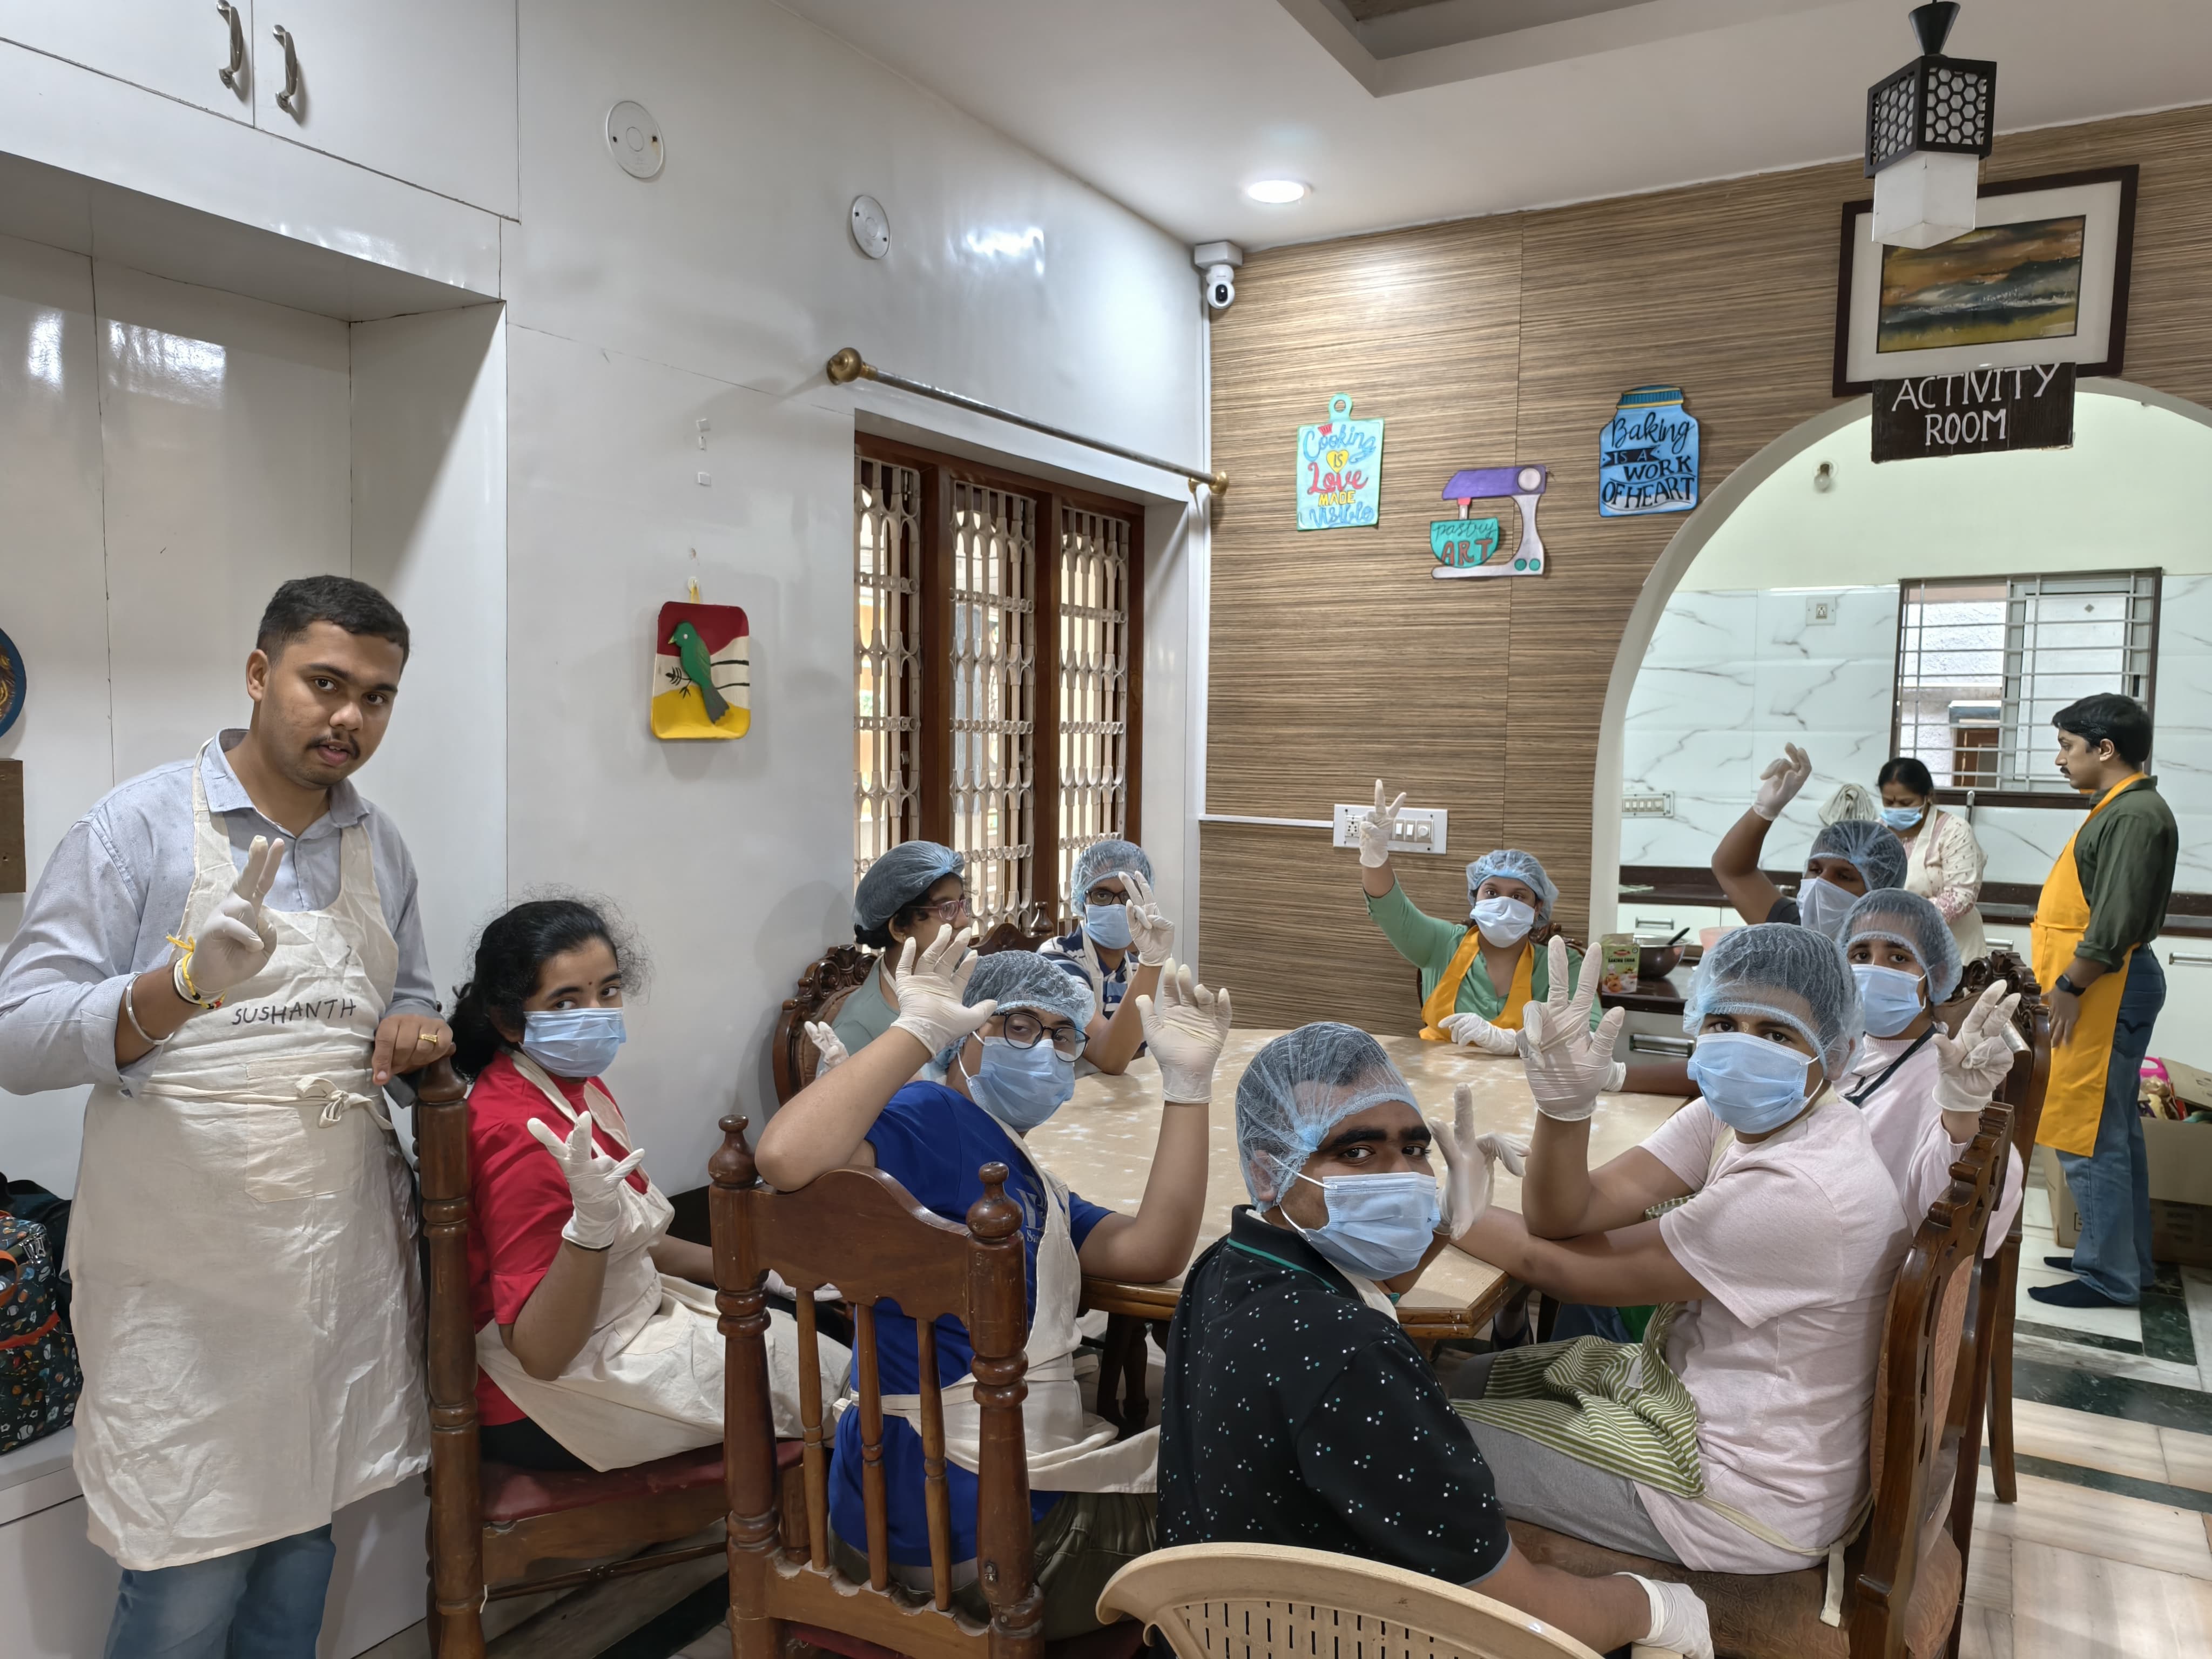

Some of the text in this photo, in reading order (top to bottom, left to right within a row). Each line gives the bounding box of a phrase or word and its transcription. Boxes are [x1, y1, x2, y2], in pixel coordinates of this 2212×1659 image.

[1891, 363, 2061, 412] ACTIVITY
[1611, 412, 1696, 454] Baking
[1925, 408, 2007, 446] ROOM
[1303, 424, 1376, 464] Cooking
[1614, 449, 1648, 463] IS A
[1333, 453, 1344, 468] IS
[1623, 455, 1693, 482] WORK
[1307, 461, 1368, 495] Love
[1602, 476, 1694, 508] OF HEART
[1318, 490, 1356, 507] MADE
[1440, 538, 1494, 567] ART
[232, 998, 357, 1026] SUSHANTH
